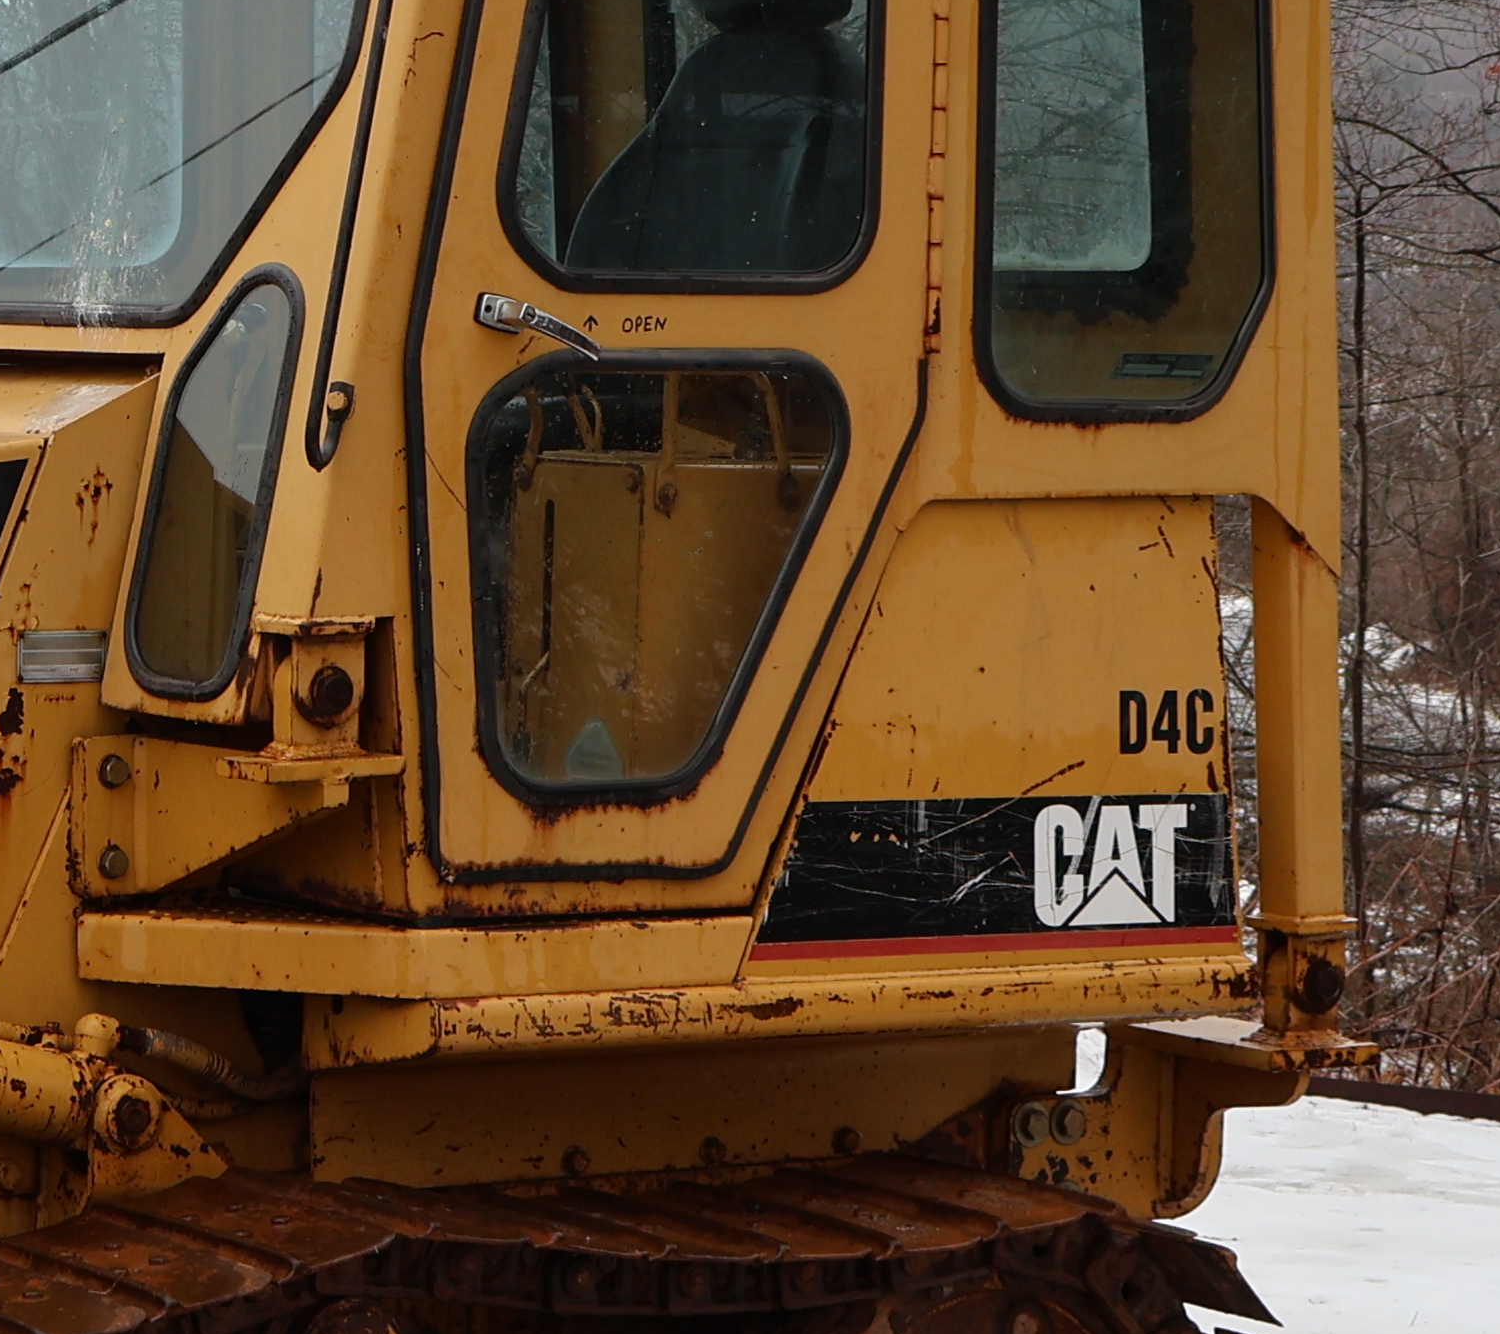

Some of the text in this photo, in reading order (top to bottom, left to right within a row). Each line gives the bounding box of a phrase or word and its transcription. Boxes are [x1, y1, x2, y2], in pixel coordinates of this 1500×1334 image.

[622, 315, 668, 333] OPEN
[1119, 688, 1214, 755] D4C
[1034, 804, 1188, 927] CAT
